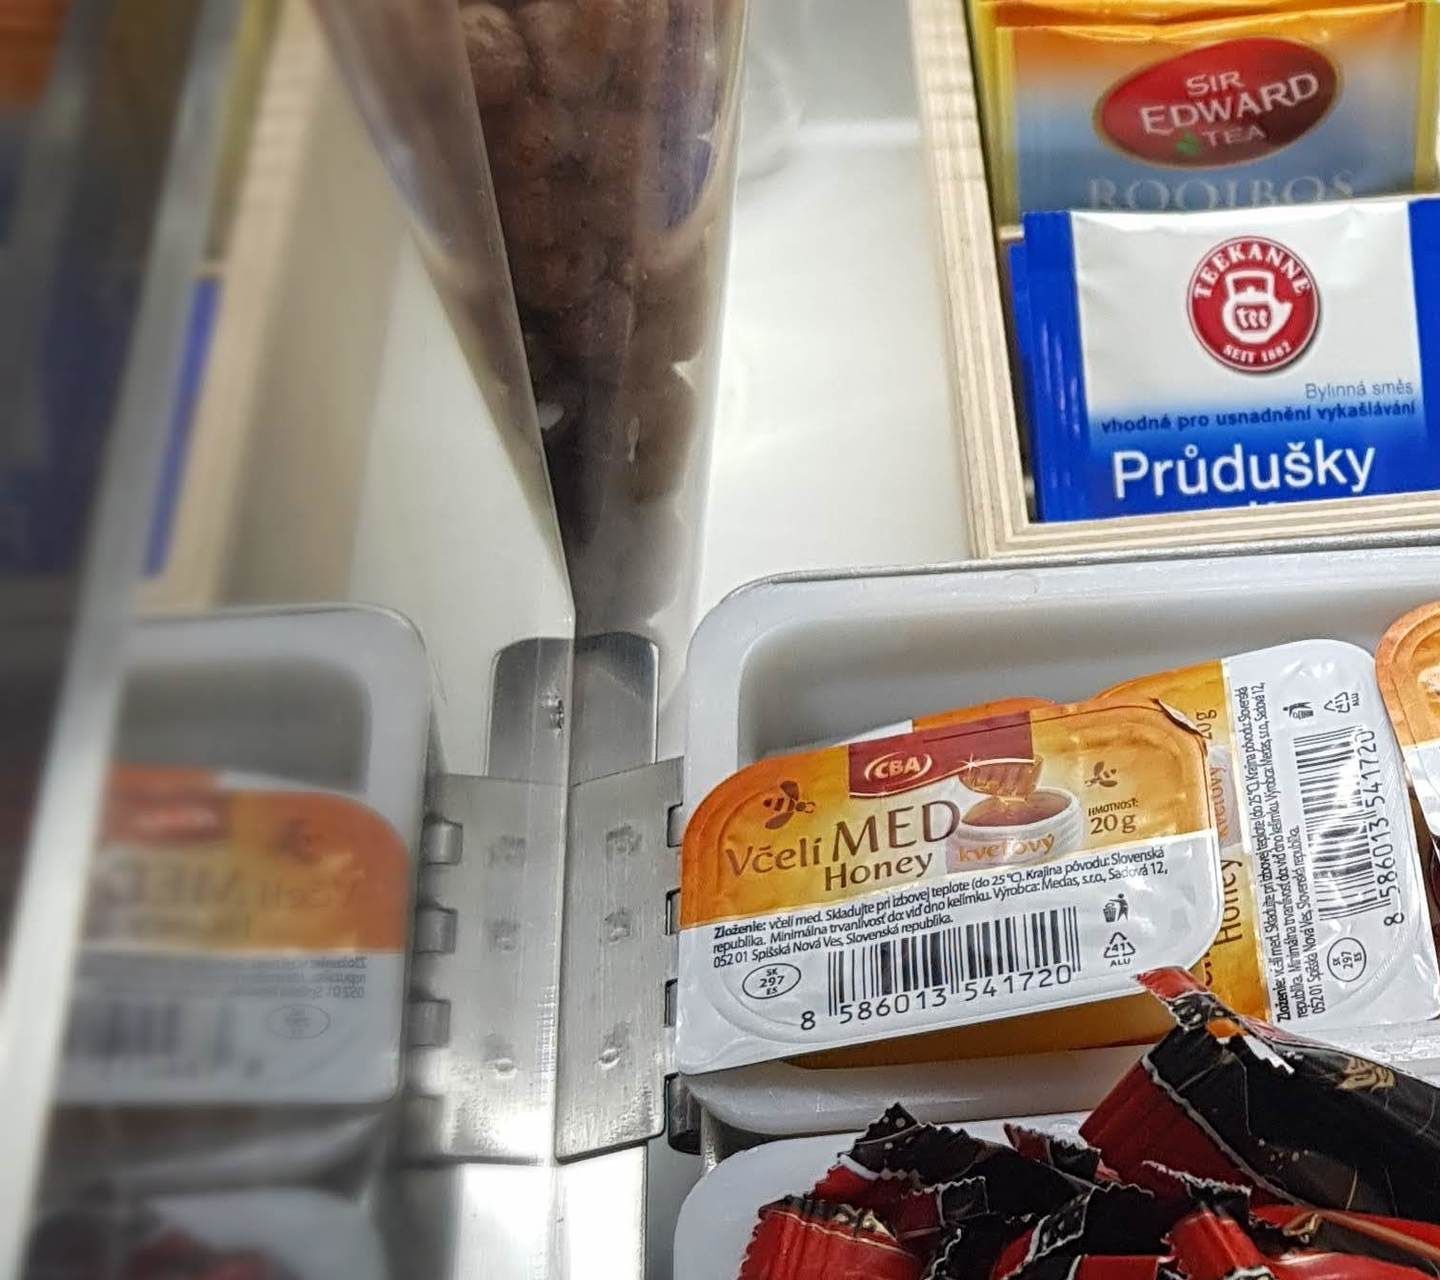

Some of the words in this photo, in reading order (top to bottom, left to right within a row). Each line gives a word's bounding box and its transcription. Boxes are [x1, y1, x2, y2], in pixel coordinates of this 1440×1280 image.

[1186, 70, 1246, 97] SIR
[1139, 72, 1320, 137] EDWARD
[1202, 125, 1267, 148] TEA
[1088, 168, 1353, 212] ROOIBOS
[1193, 243, 1313, 298] TEEKANNE
[1236, 307, 1269, 329] tee
[1305, 380, 1367, 402] Bylinná
[1371, 378, 1415, 396] směs
[1101, 413, 1172, 434] vhodná
[1177, 413, 1209, 433] pro
[1216, 403, 1313, 426] usnadnění
[1316, 399, 1417, 423] vykašlávání
[1112, 437, 1377, 501] Průdušky
[873, 755, 923, 781] CBA
[1354, 730, 1386, 809] 541720
[1249, 795, 1263, 805] 25
[724, 836, 823, 877] Včelí
[831, 798, 962, 862] MED
[1089, 814, 1119, 836] 20
[1122, 813, 1138, 835] g
[823, 849, 934, 892] Honey
[1368, 817, 1400, 901] 586013
[713, 922, 767, 940] Zloženie:
[769, 913, 795, 931] včelí
[825, 900, 876, 922] Skladujte
[876, 897, 892, 915] pri
[892, 887, 931, 909] izbovej
[931, 878, 970, 899] teplote
[971, 875, 990, 891] (do
[991, 872, 1006, 886] 25
[1026, 863, 1063, 882] Krajina
[1111, 846, 1165, 866] Slovenská
[1285, 868, 1311, 910] Slovenská
[713, 934, 767, 955] republika.
[769, 923, 828, 945] Minimálna
[924, 900, 947, 916] dno
[992, 881, 1042, 903] Výrobca:
[1041, 874, 1082, 892] Medas,
[1150, 860, 1169, 876] 12,
[1383, 911, 1405, 926] 8
[713, 952, 735, 969] 052
[734, 950, 750, 965] 01
[751, 942, 791, 964] Spišská
[793, 935, 822, 954] Nová
[846, 923, 900, 947] Slovenská
[900, 913, 954, 935] republika.
[1111, 941, 1127, 954] 41
[1292, 927, 1315, 951] Nová
[1109, 957, 1132, 969] ALU
[1340, 951, 1354, 970] 297
[759, 975, 786, 990] 297
[800, 1009, 817, 1031] 8
[839, 987, 948, 1025] 586013
[964, 963, 1073, 1000] 541720
[1305, 984, 1323, 998] 01
[1274, 978, 1292, 1022] Zloženie:
[1307, 998, 1327, 1014] 052
